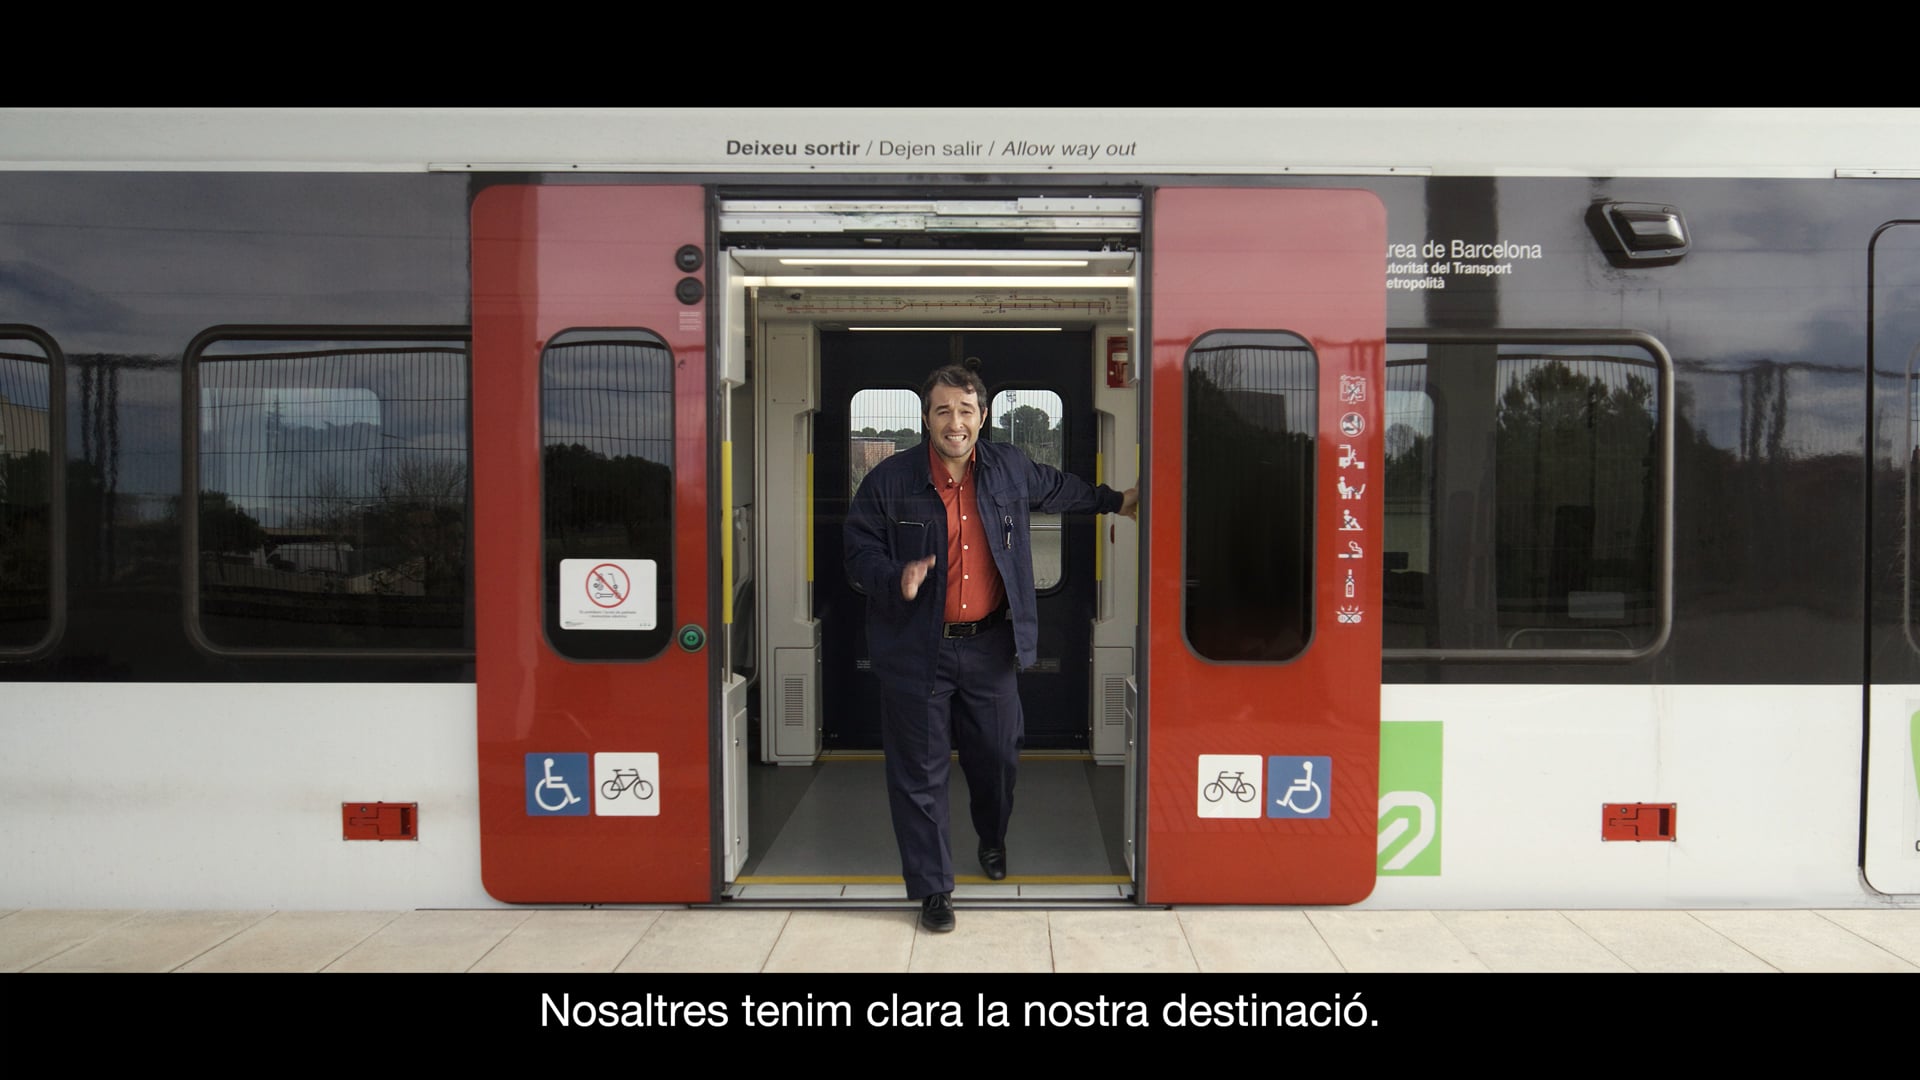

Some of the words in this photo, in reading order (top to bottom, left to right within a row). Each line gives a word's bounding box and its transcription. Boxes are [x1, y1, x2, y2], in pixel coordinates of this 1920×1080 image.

[726, 139, 797, 156] Deixeu
[804, 139, 861, 156] sortir
[865, 140, 873, 157] /
[879, 140, 936, 160] Dejen
[942, 140, 983, 156] salir
[988, 140, 996, 157] /
[1001, 140, 1056, 156] Allow
[1061, 144, 1100, 160] way
[1106, 141, 1137, 156] out
[1386, 243, 1417, 259] rea
[1422, 240, 1446, 259] de
[1451, 239, 1542, 259] Barcelona
[1386, 261, 1428, 274] utoritat
[1431, 261, 1450, 274] del
[1453, 261, 1512, 277] Transport
[1386, 276, 1445, 292] etropolità
